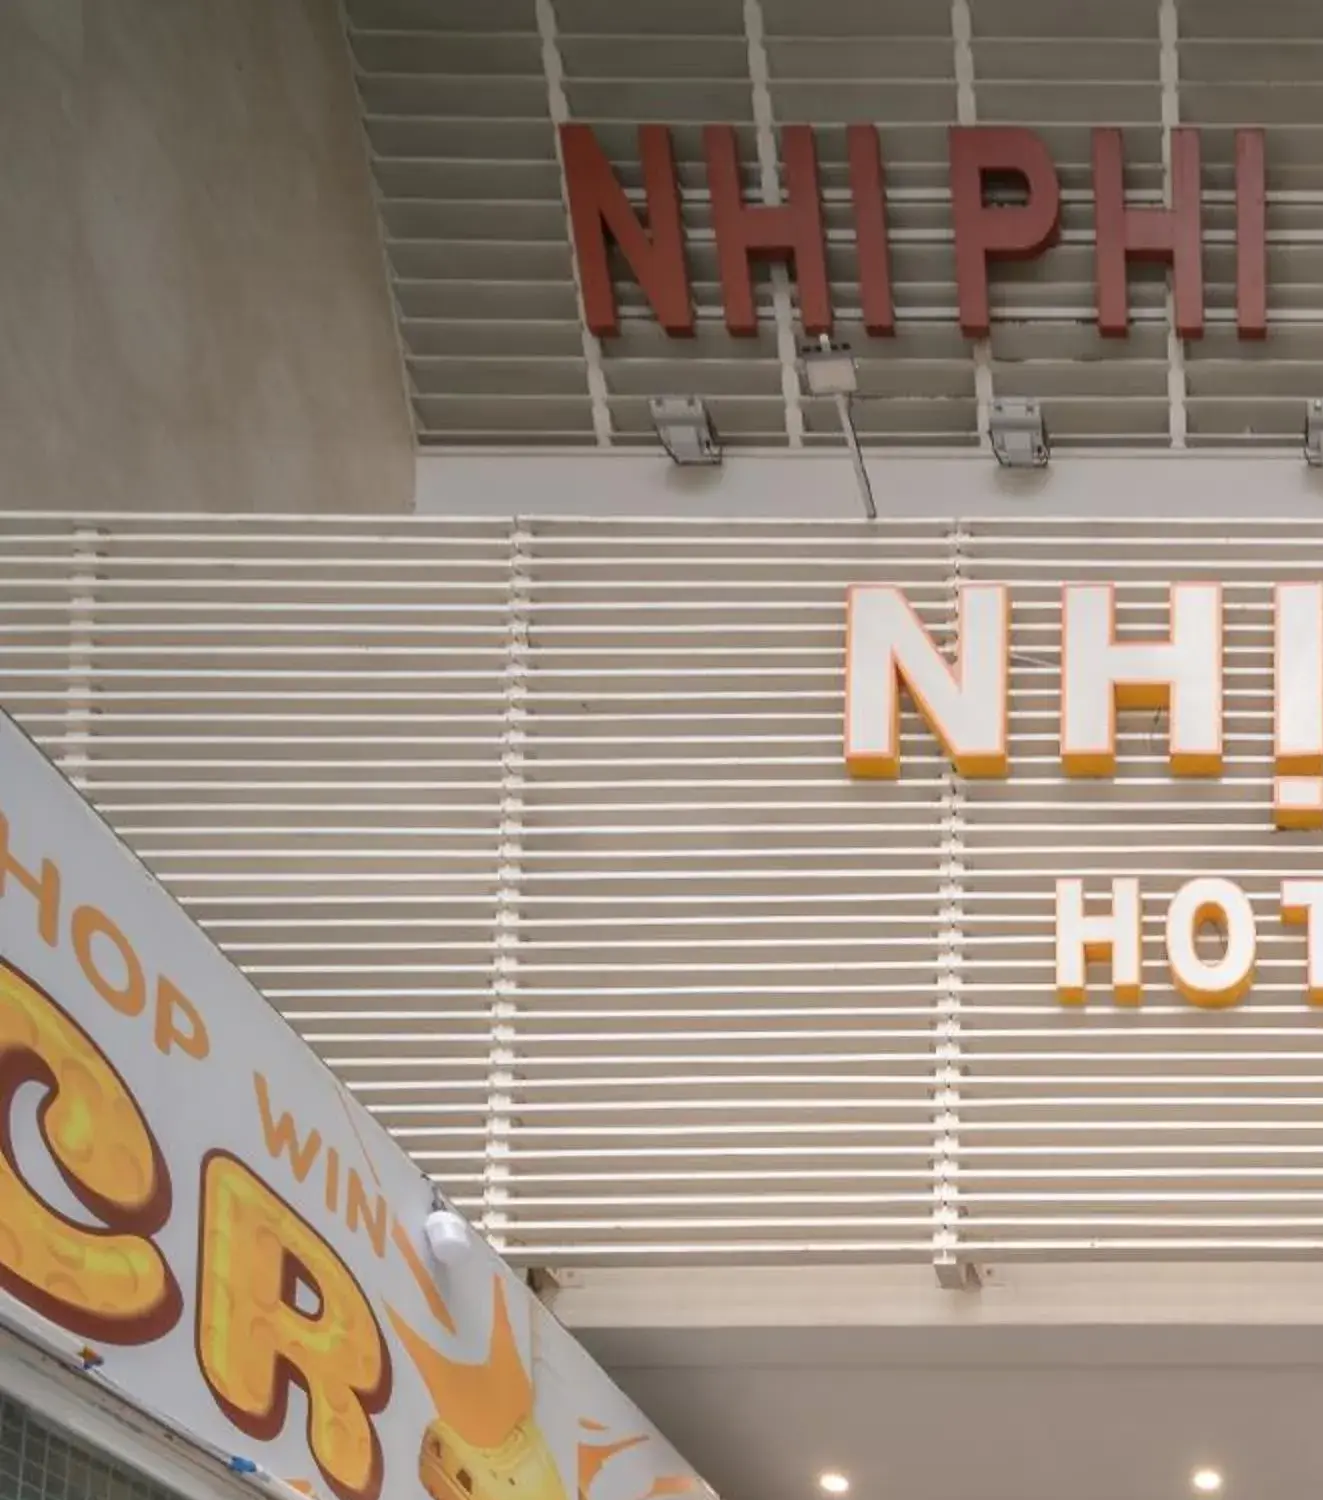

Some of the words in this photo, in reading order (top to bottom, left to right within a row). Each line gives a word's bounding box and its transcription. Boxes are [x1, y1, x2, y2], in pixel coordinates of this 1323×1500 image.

[557, 123, 896, 339] NHI
[949, 125, 1267, 340] PHI
[253, 1070, 388, 1259] WIN
